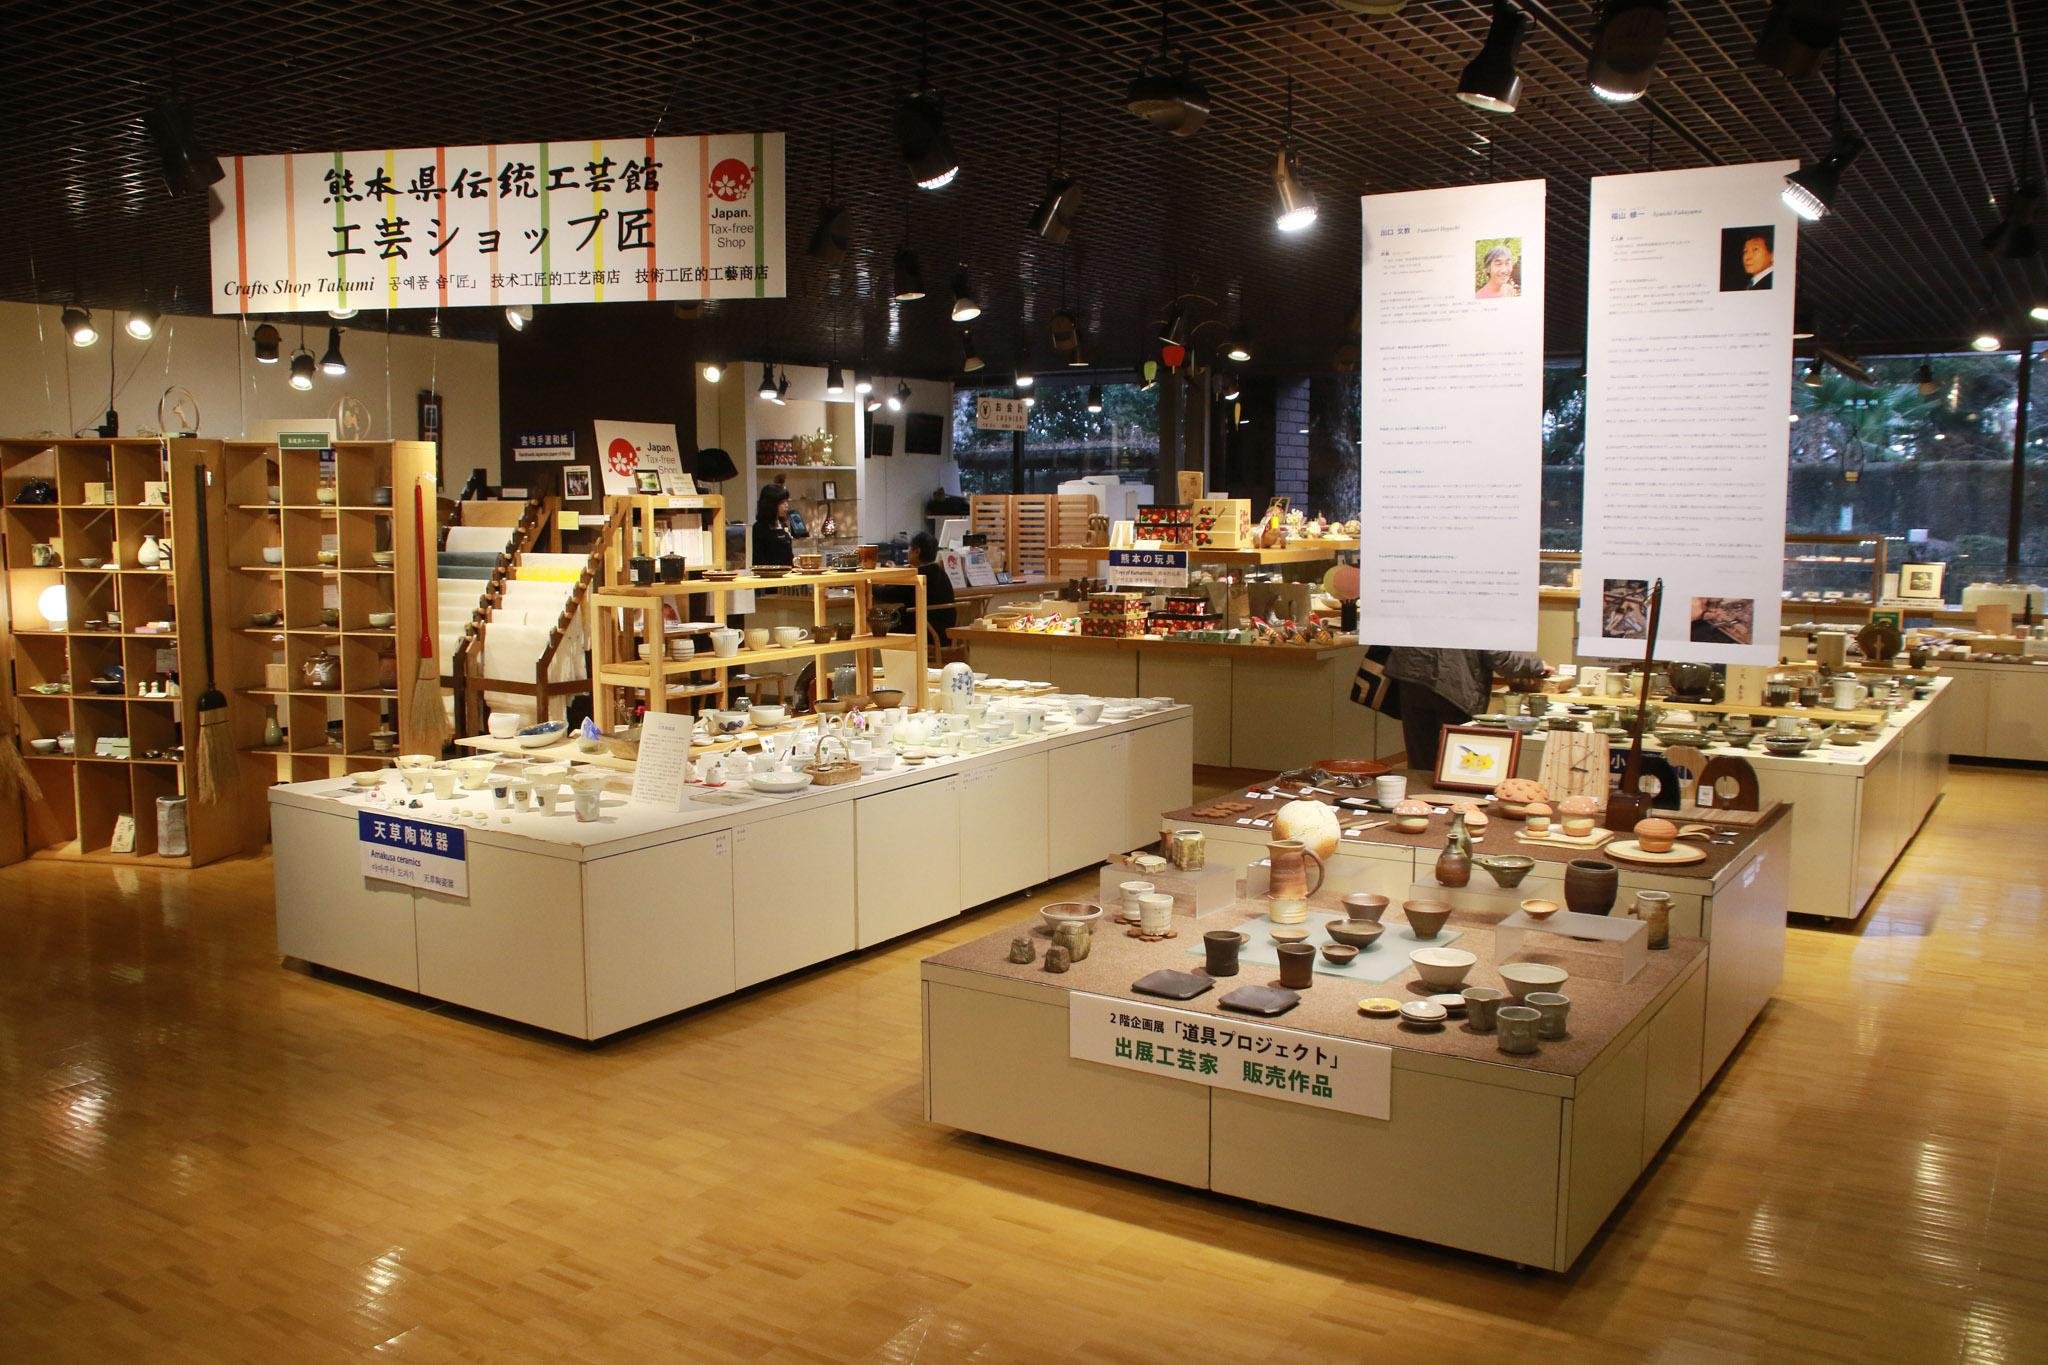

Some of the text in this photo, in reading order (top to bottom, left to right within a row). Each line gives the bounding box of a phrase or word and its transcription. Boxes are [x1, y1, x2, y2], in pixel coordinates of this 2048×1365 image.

[323, 156, 663, 204] 熊本県伝統工芸館
[711, 207, 752, 220] Japan.
[327, 207, 656, 260] 工芸ショップ匠
[709, 223, 754, 234] Tax-free
[717, 237, 746, 249] Shop
[388, 275, 429, 291] 공예품
[490, 264, 769, 288] 技术工匠的工艺商店 技術工匠的工藝商店
[223, 276, 376, 298] Crafts Shop Takumi
[647, 442, 673, 453] Japan.
[645, 455, 676, 464] Tax-free
[1120, 553, 1176, 565] 熊本の玩具
[373, 820, 449, 852] 天草陶磁器
[370, 849, 421, 867] Amakusa ceramics
[1115, 1036, 1333, 1099] 出展工芸家 販売作品
